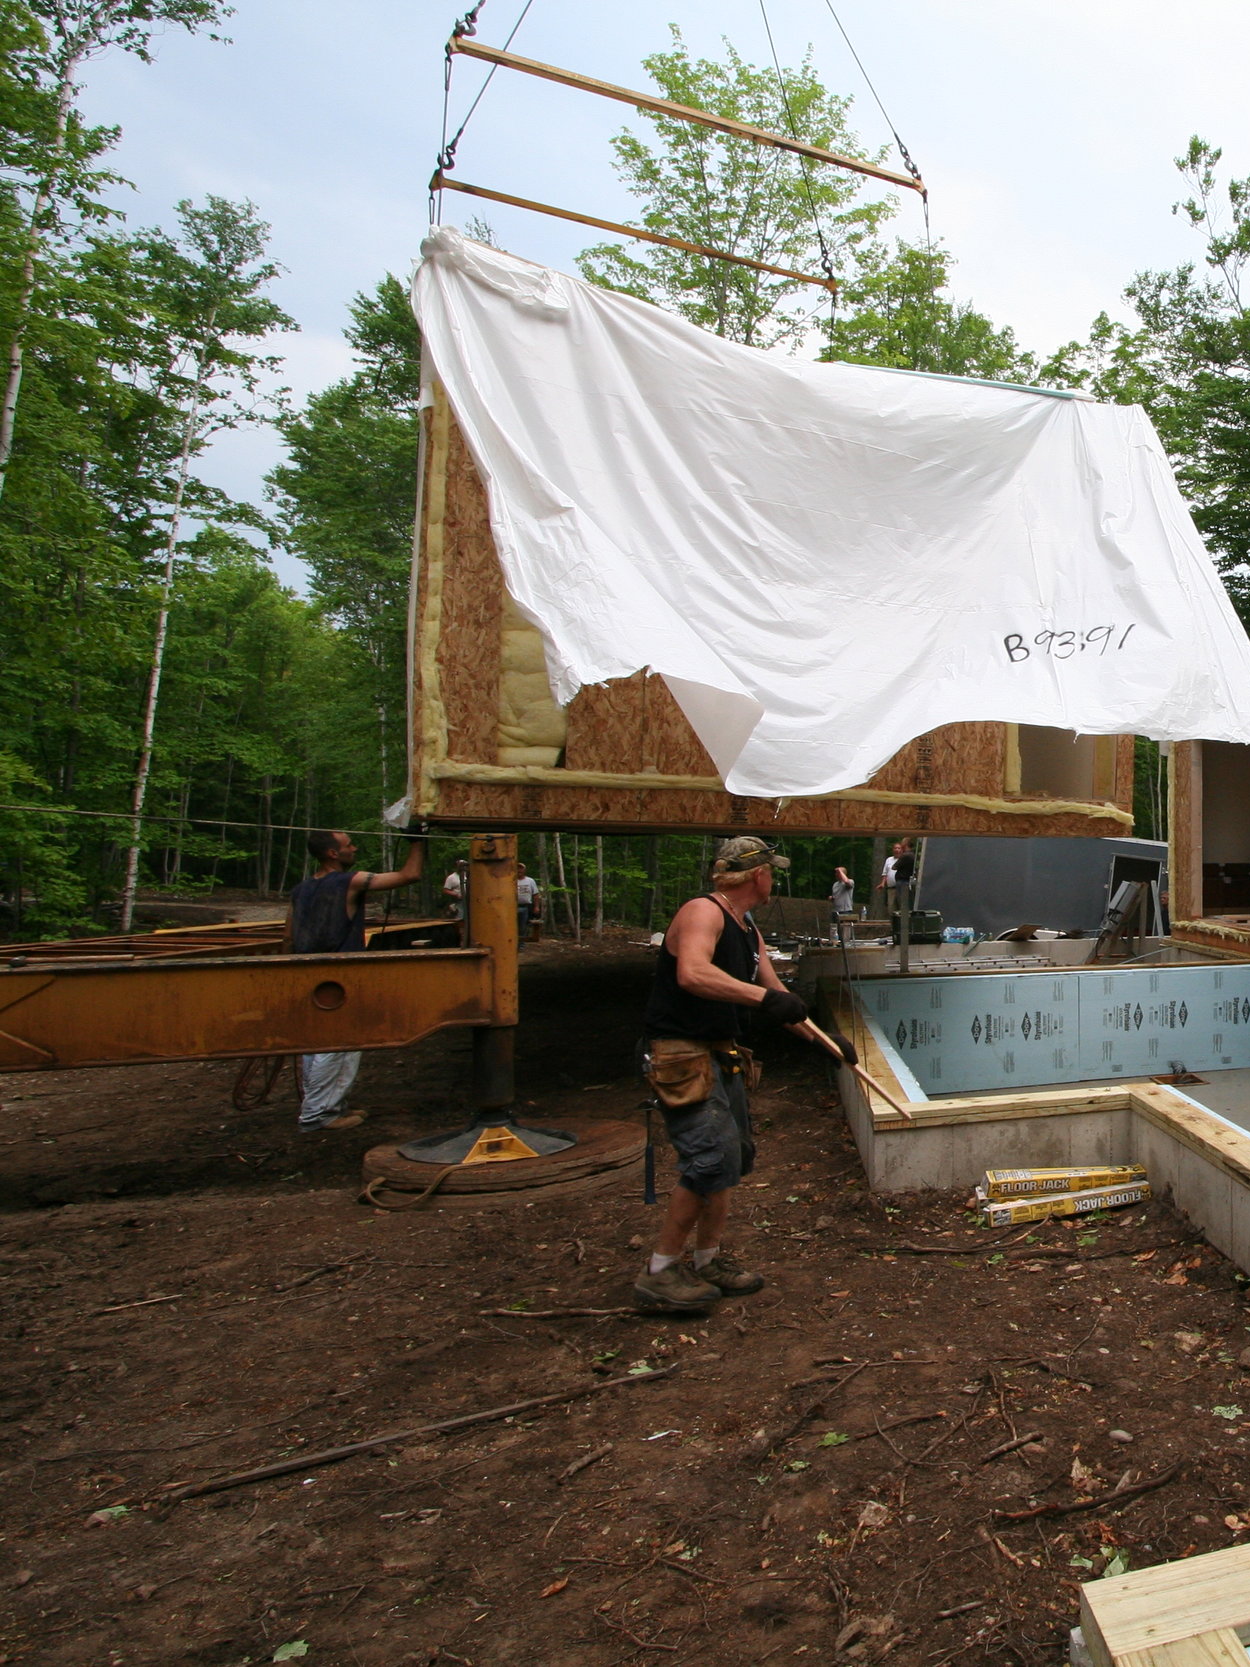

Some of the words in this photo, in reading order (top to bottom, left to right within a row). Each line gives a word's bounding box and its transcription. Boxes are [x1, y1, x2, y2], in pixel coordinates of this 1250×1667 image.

[1001, 1181, 1037, 1192] FLOOR
[1040, 1179, 1069, 1190] JACK
[1074, 1197, 1104, 1211] JACK
[1106, 1190, 1141, 1206] FLOOR
